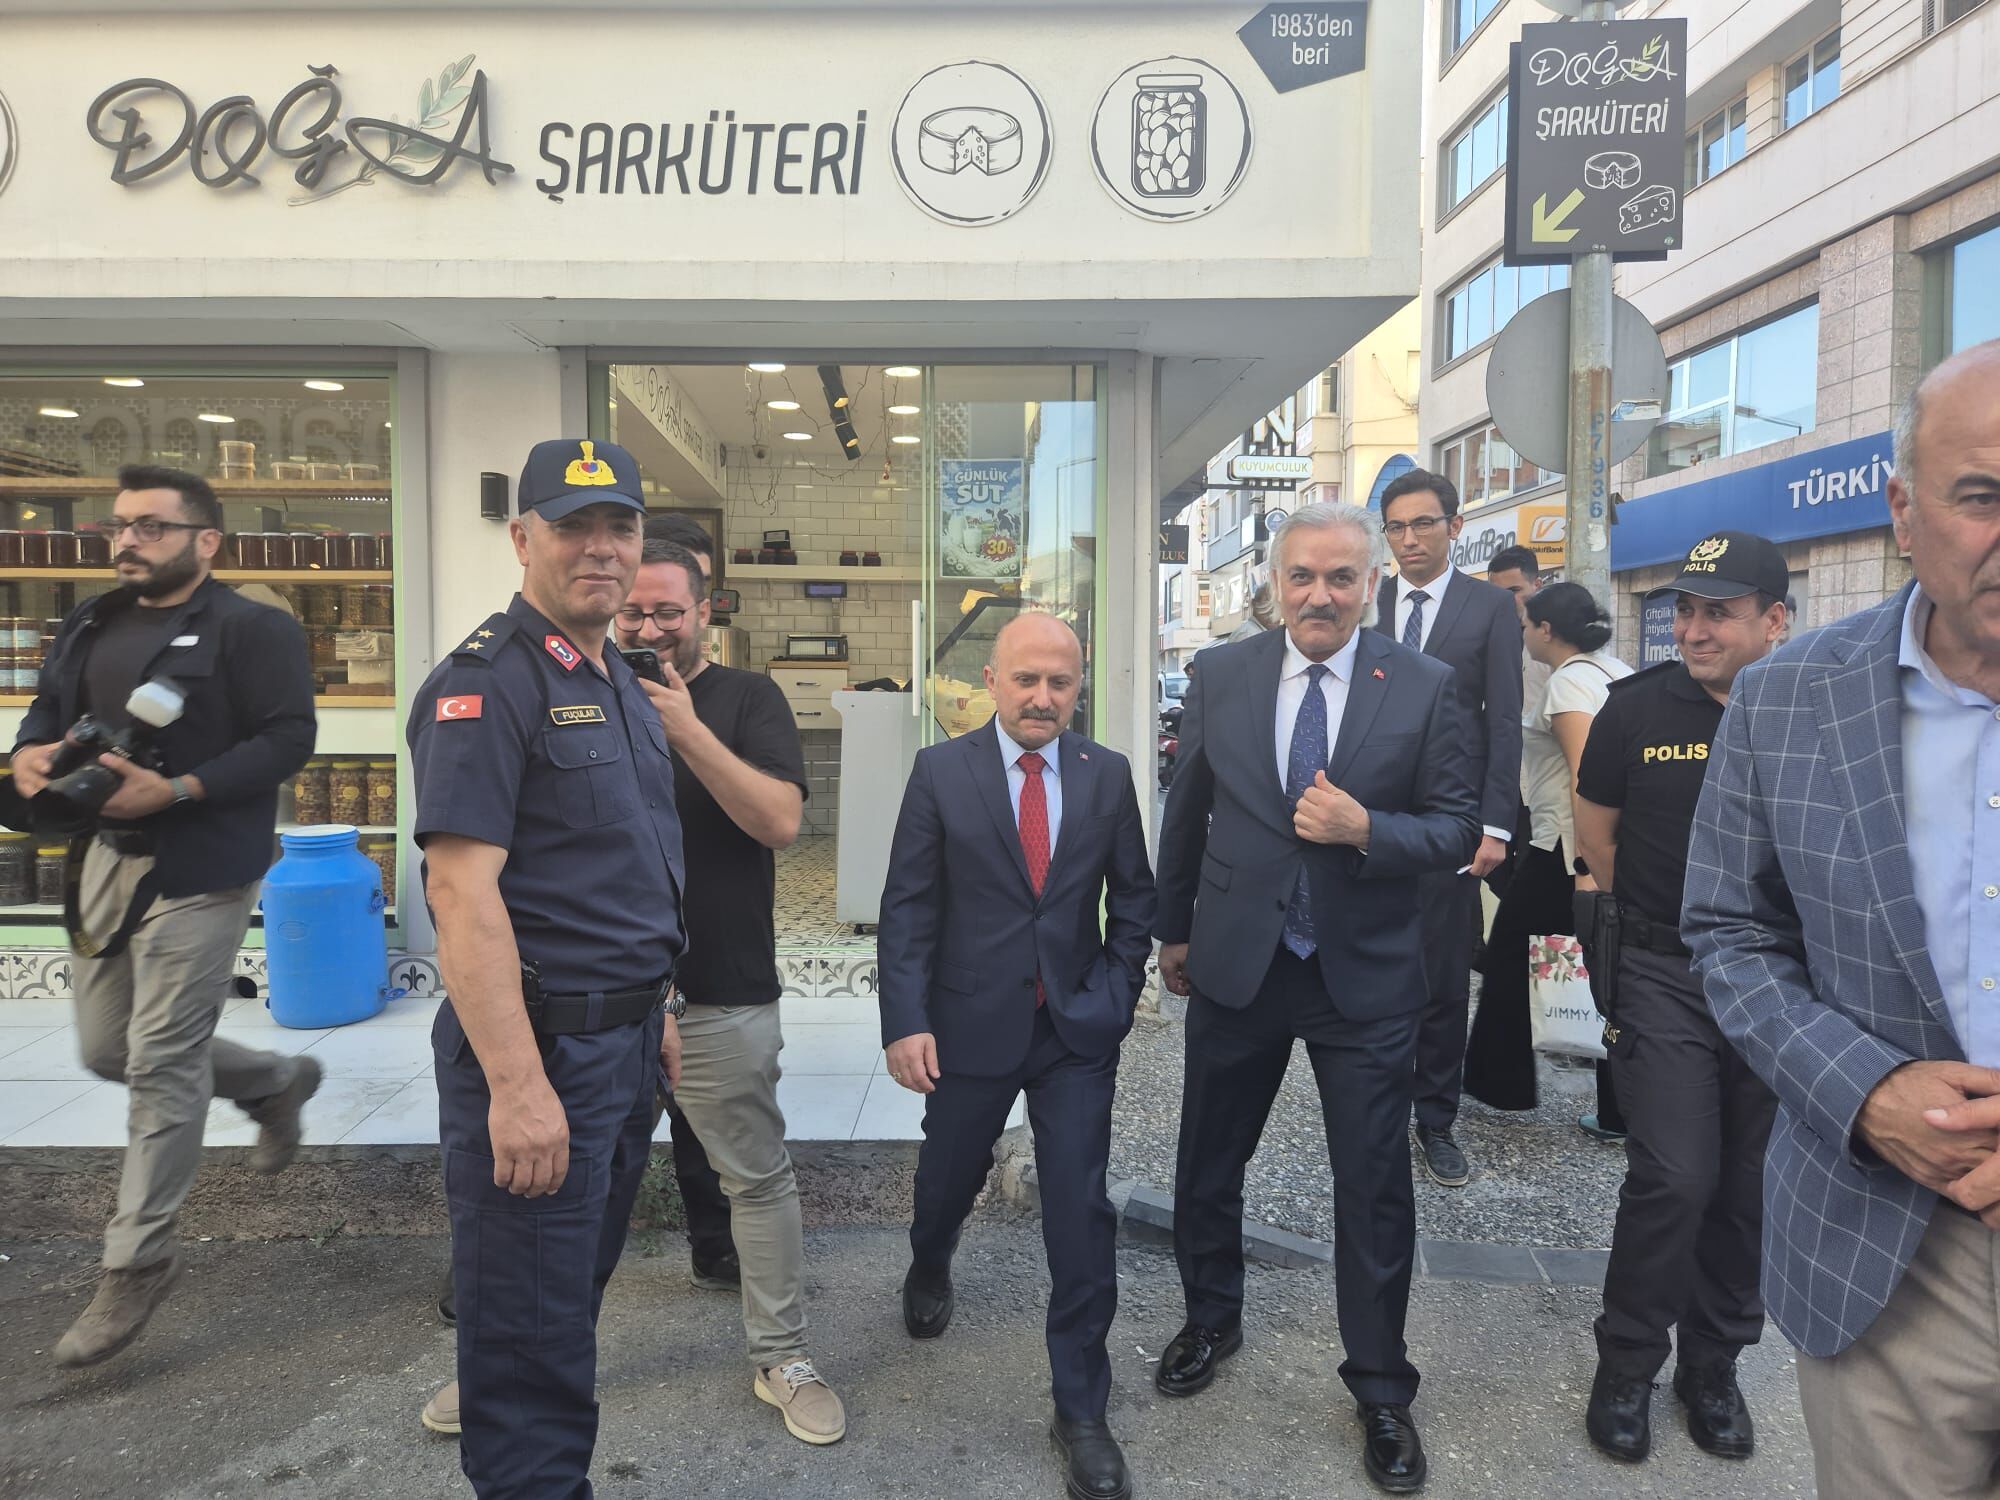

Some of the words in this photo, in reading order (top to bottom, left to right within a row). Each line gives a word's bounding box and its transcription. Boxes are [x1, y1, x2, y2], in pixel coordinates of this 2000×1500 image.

[1270, 13, 1353, 37] 1983'den
[1292, 42, 1330, 65] beri
[1529, 40, 1678, 86] DOĞA
[1536, 98, 1669, 141] ŞARKÜTERİ
[87, 64, 517, 188] DOĞA
[536, 110, 867, 204] ŞARKÜTERİ
[954, 467, 1009, 483] GÜNLÜK
[1239, 461, 1308, 473] KUYUMCULUK
[956, 482, 1005, 504] SÜT
[1545, 1006, 1590, 1021] JIMMY
